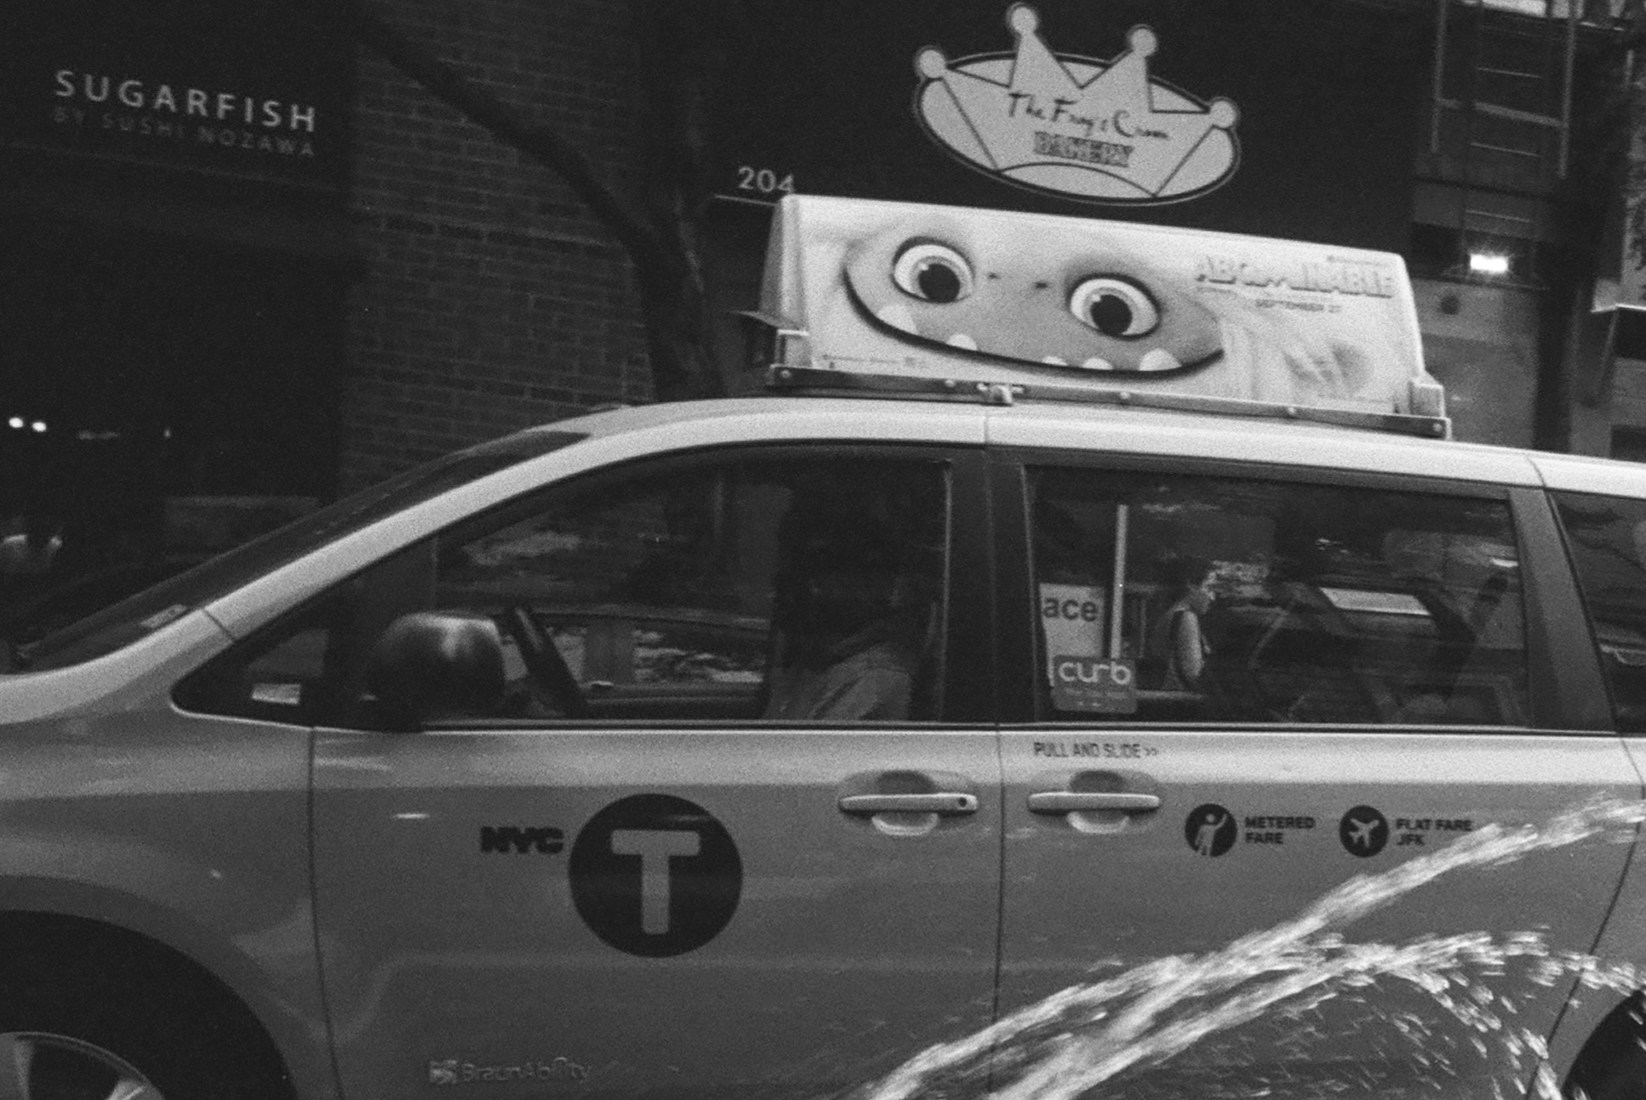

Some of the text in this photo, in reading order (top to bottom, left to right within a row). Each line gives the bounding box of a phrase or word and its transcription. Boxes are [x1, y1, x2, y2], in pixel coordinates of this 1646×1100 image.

[55, 70, 315, 132] SUGARFISH
[1009, 92, 1046, 120] The
[102, 112, 184, 139] SUSHI
[200, 126, 315, 157] NOZAWA
[1034, 131, 1136, 168] BAKERY
[738, 166, 794, 194] 204
[1195, 255, 1394, 299] ABOMINABLE
[1043, 598, 1098, 622] ace
[1059, 661, 1131, 685] curb
[1033, 742, 1141, 758] PULL AND SLIDE
[1245, 816, 1316, 829] METERED
[1396, 818, 1473, 832] FLAT FARE
[480, 826, 564, 853] NYC
[1245, 832, 1284, 845] FARE
[1397, 834, 1425, 846] JFK
[611, 829, 701, 934] T
